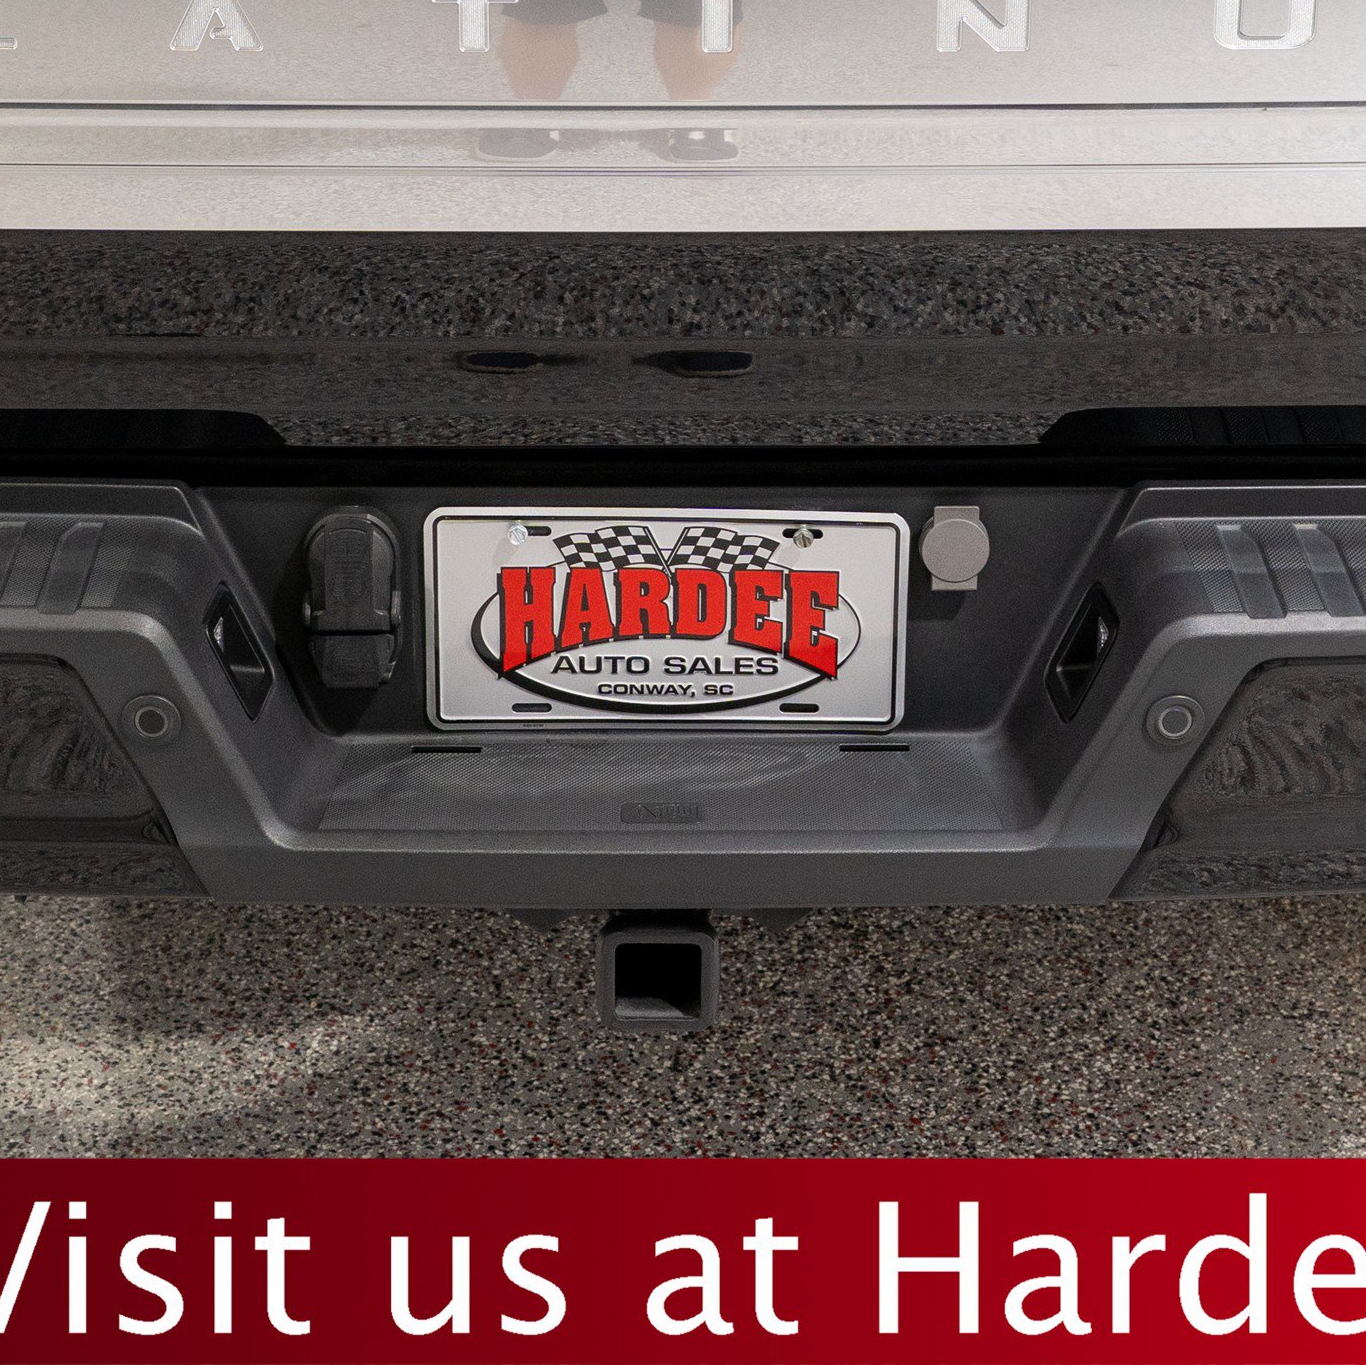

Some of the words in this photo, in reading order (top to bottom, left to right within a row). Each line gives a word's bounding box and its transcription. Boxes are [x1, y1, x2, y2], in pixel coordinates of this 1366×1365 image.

[497, 565, 839, 681] HARDEE
[550, 655, 650, 675] AUTO
[663, 655, 780, 677] SALES
[597, 682, 697, 698] CONWAY,
[703, 682, 734, 696] SC
